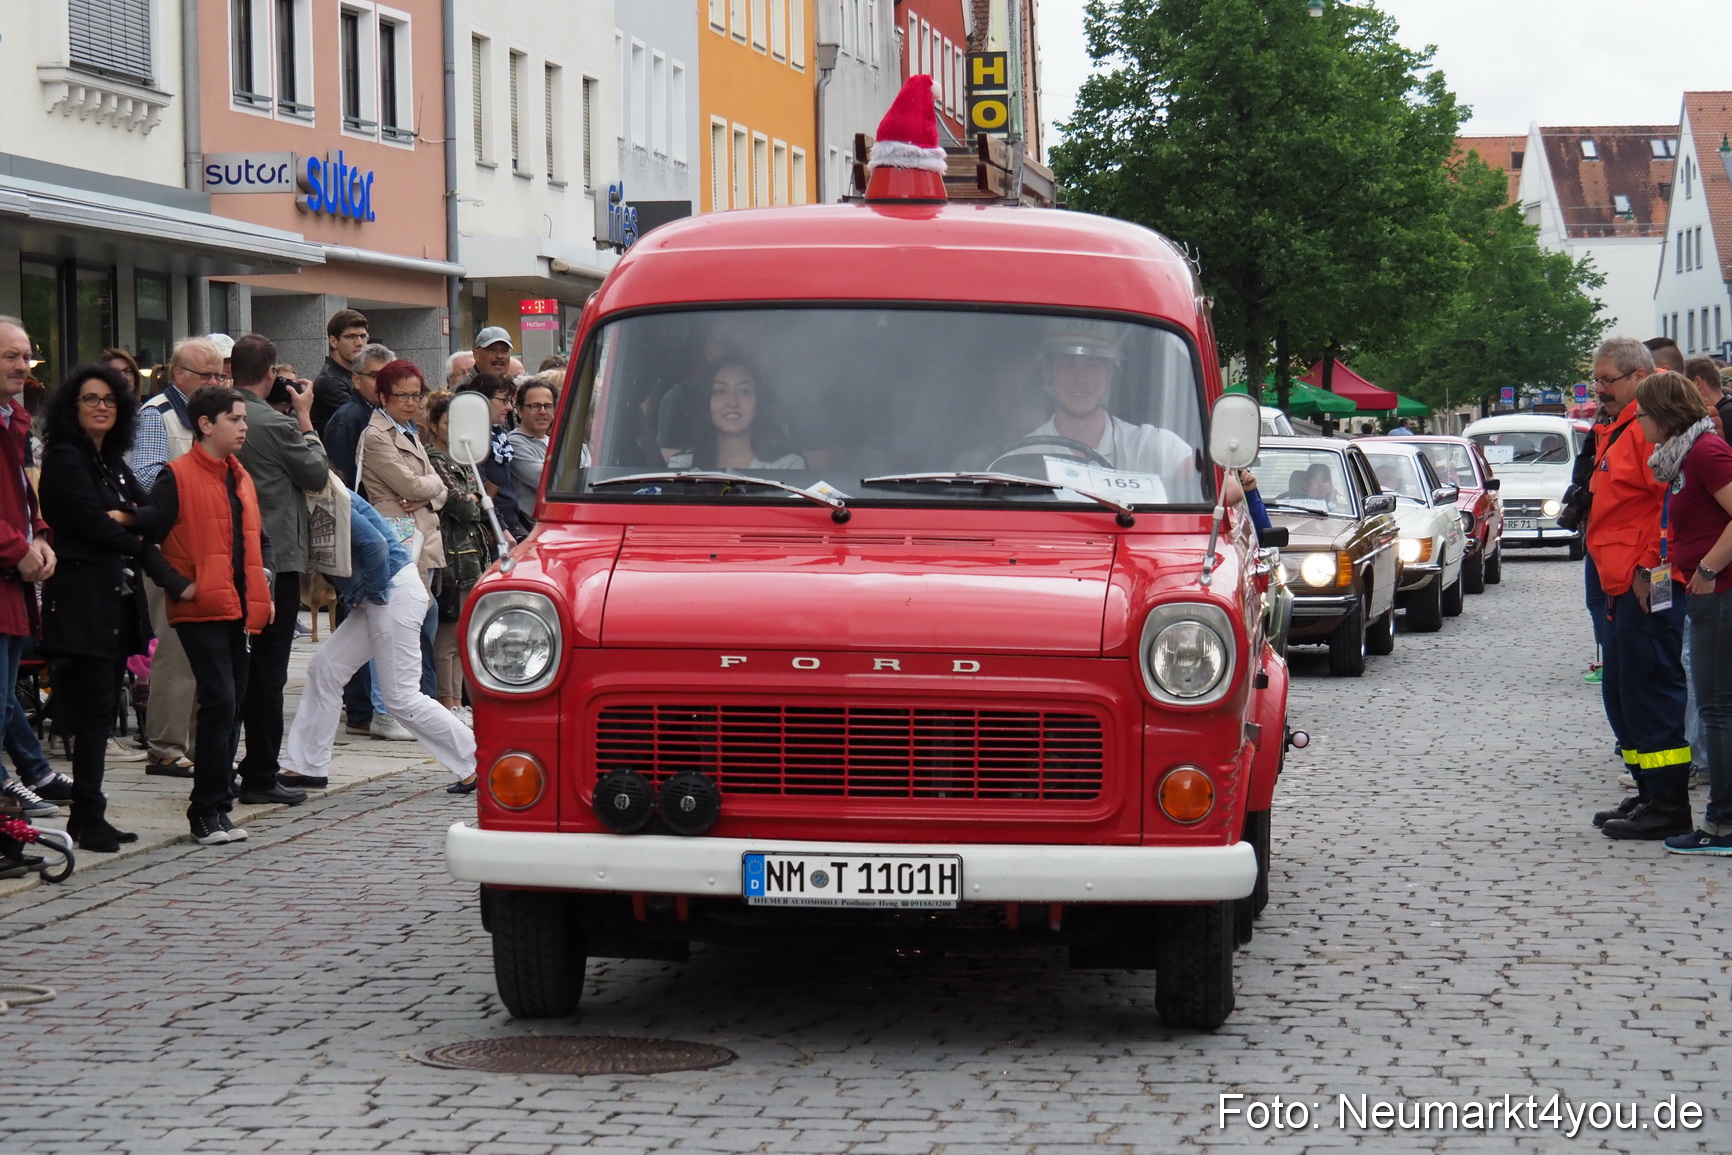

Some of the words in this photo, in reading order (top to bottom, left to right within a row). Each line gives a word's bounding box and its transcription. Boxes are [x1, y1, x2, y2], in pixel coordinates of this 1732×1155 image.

[205, 159, 290, 185] sutor.
[307, 150, 376, 222] sutor.
[526, 321, 546, 329] HotSpot
[1102, 478, 1141, 489] 165
[1508, 520, 1519, 528] RF
[1520, 520, 1531, 528] 71
[720, 656, 981, 672] FORD
[751, 879, 760, 889] D
[766, 861, 804, 892] NM
[831, 862, 848, 893] T
[858, 863, 956, 894] 1101H
